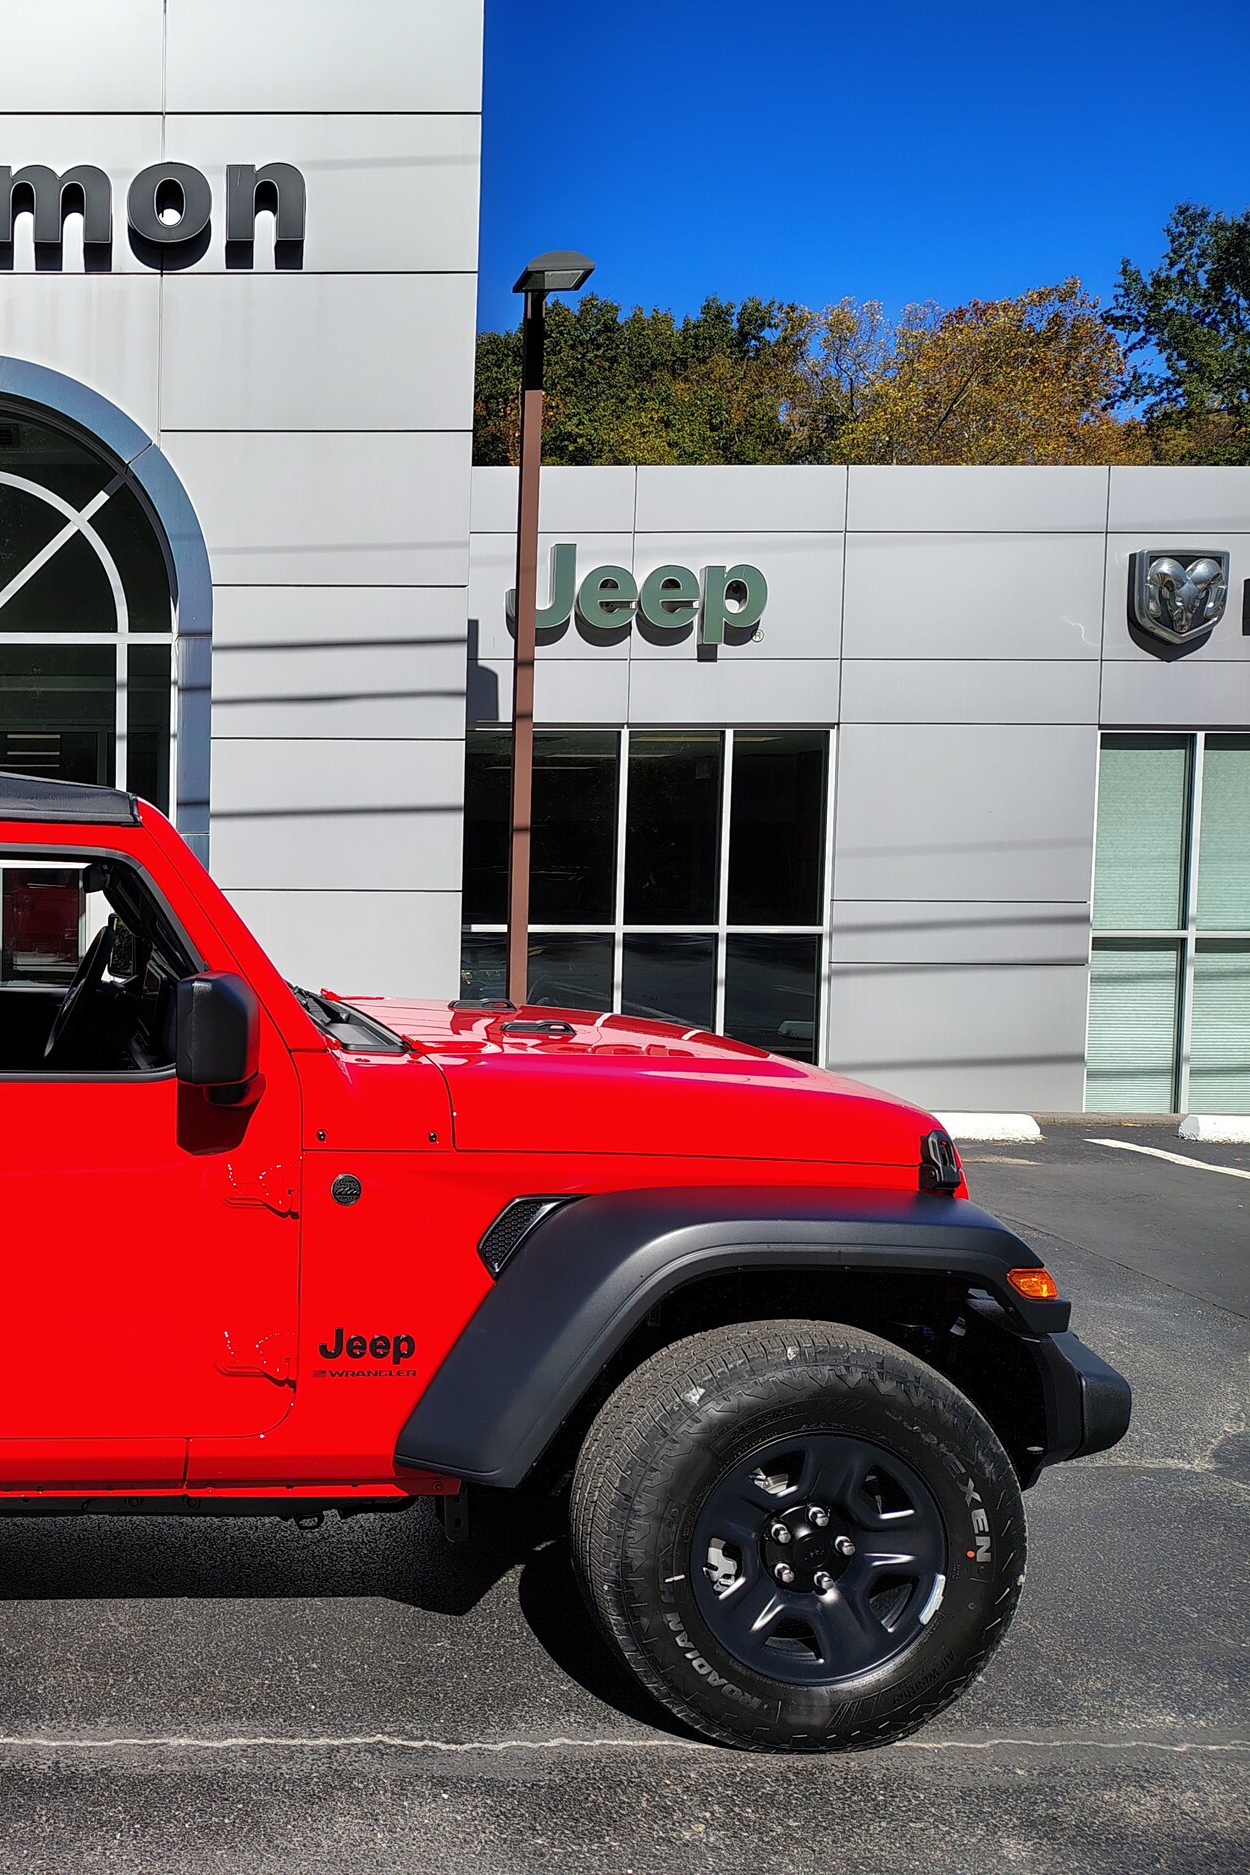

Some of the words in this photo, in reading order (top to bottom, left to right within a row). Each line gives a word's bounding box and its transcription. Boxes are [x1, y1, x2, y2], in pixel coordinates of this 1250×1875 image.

[505, 543, 768, 645] Jeep
[318, 1327, 415, 1365] Jeep
[328, 1369, 417, 1377] WRANGLER
